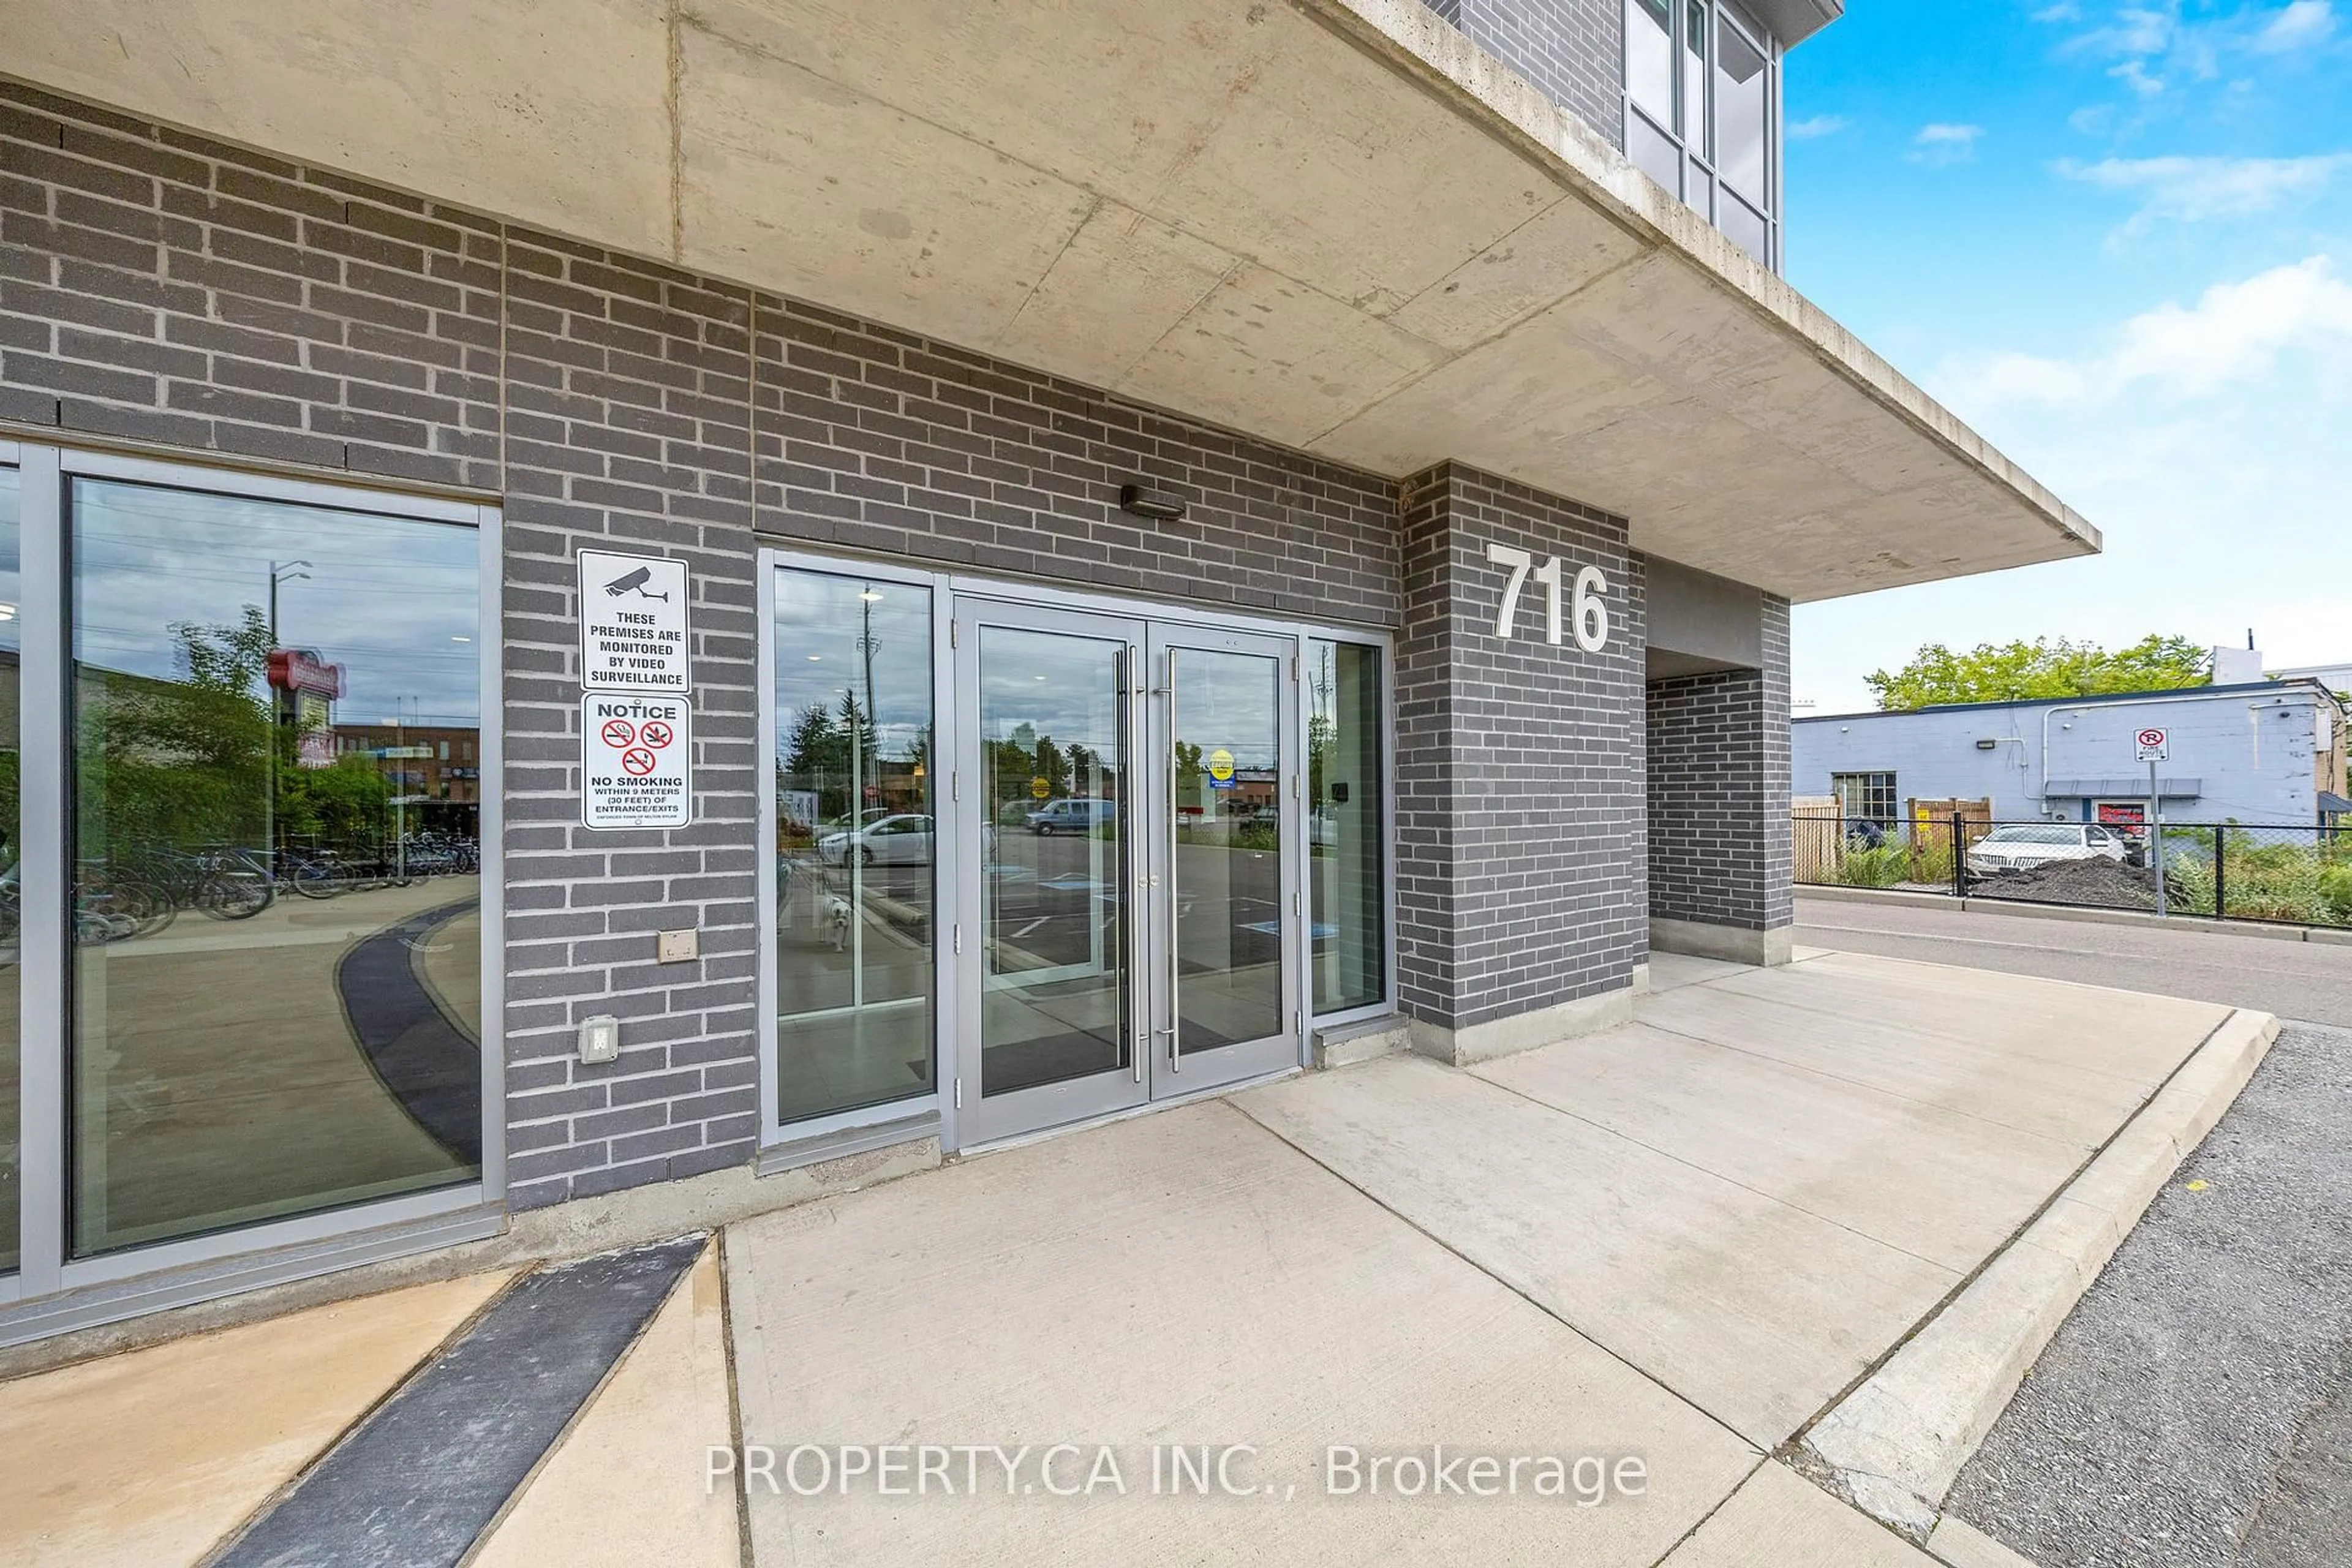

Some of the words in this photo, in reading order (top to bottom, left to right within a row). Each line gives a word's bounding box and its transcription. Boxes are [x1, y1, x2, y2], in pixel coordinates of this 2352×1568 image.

[1487, 543, 1608, 653] 716
[616, 612, 655, 625] THESE
[590, 625, 654, 639] PREMISES
[658, 631, 681, 641] ARE
[600, 641, 673, 655] MONITORED
[609, 657, 625, 667] BY
[628, 658, 665, 669] VIDEO
[591, 671, 683, 685] SURVEILLANCE
[597, 704, 676, 720] NOTICE
[592, 777, 612, 786] NO
[617, 777, 682, 786] SMOKING
